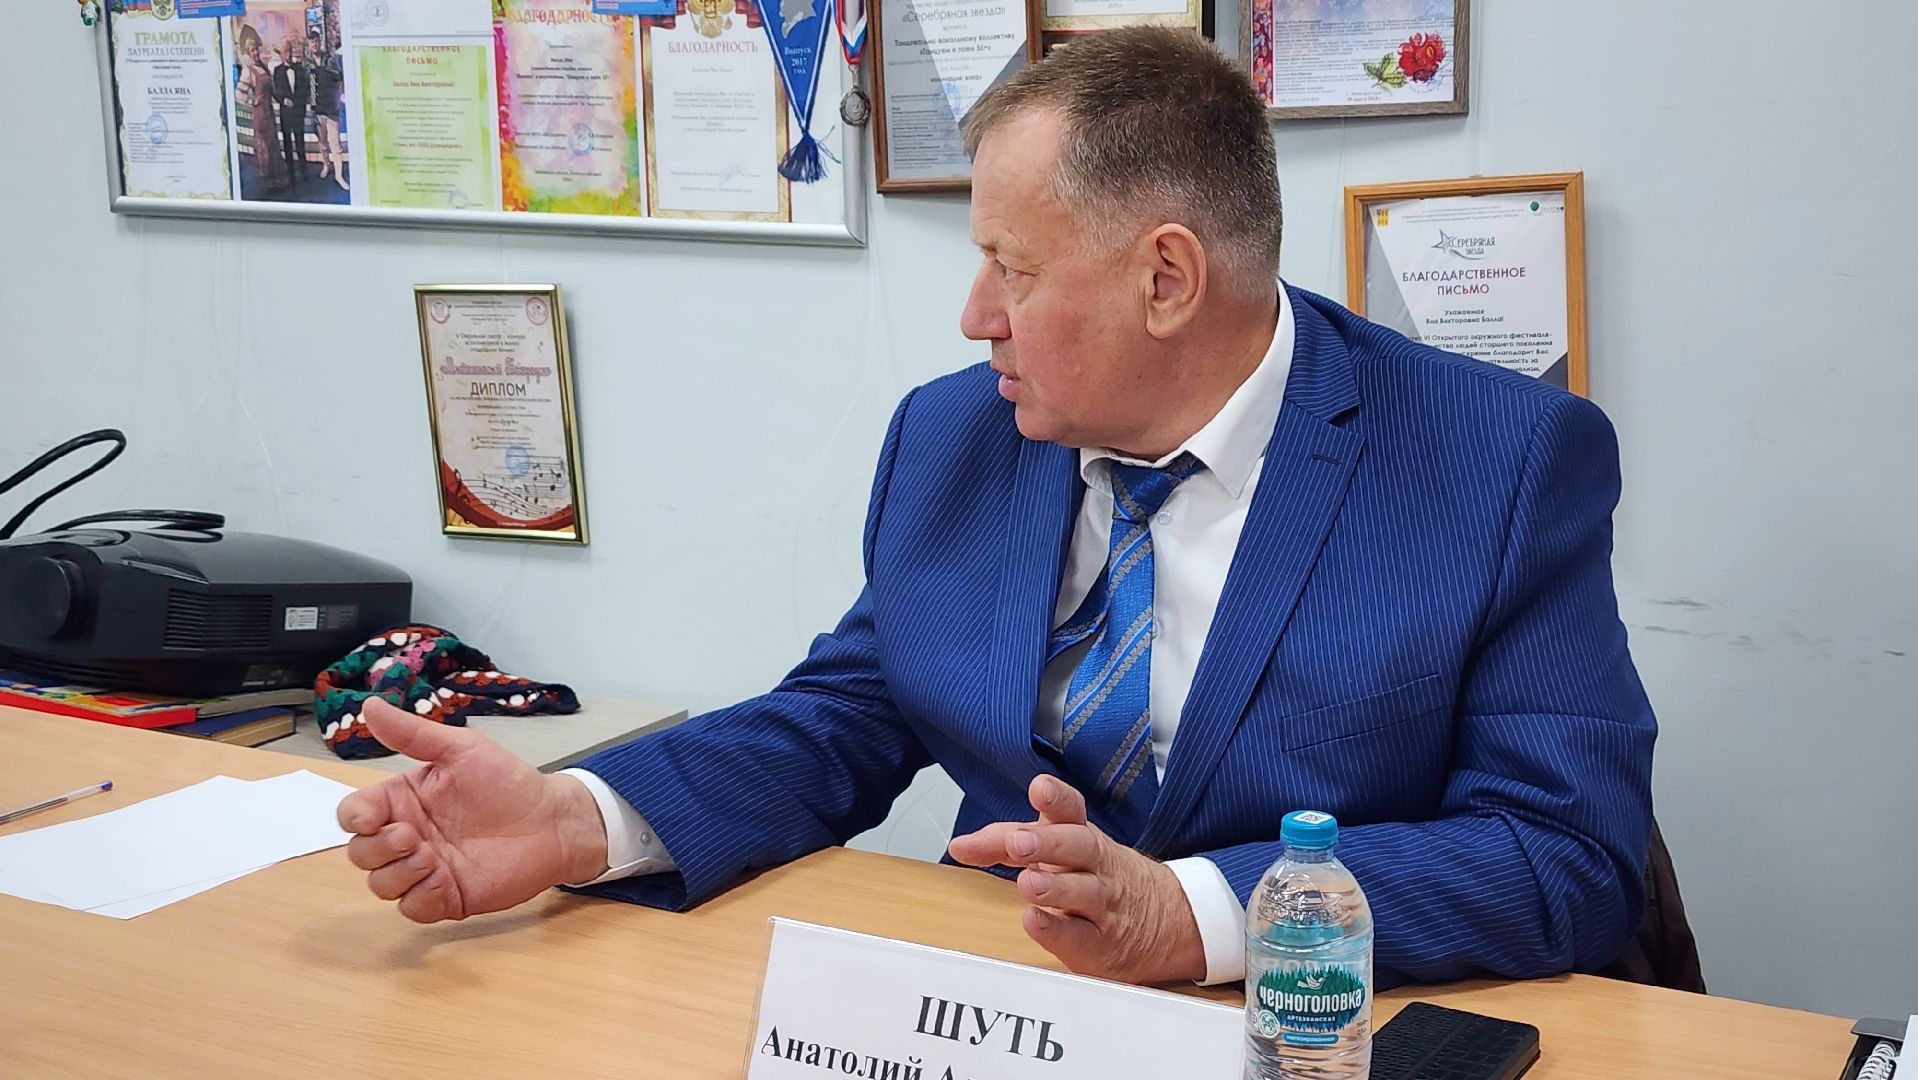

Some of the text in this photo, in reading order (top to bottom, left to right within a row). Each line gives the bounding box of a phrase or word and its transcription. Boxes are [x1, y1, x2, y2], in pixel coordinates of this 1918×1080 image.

[135, 31, 198, 46] ГРАМОТА
[127, 47, 165, 56] ЛАУРЕАТА
[668, 40, 758, 53] БЛАГОДАРНОСТЬ
[405, 57, 439, 65] ПИСЬМО
[147, 86, 192, 95] БАЛЛА ЯНА
[1402, 267, 1527, 283] БЛАГОДАРСТВЕННОЕ
[1437, 283, 1490, 296] ПИСЬМО
[1444, 308, 1485, 316] Уважаемая
[1439, 317, 1480, 325] Викторовна
[1471, 333, 1508, 341] окружного
[1479, 342, 1514, 350] старшего
[1493, 349, 1535, 357] благодарит
[470, 382, 527, 397] ДИПЛОМ
[1259, 985, 1362, 1014] черноголовка
[913, 994, 1064, 1063] ШУТЬ
[760, 1025, 924, 1080] Анатолий
